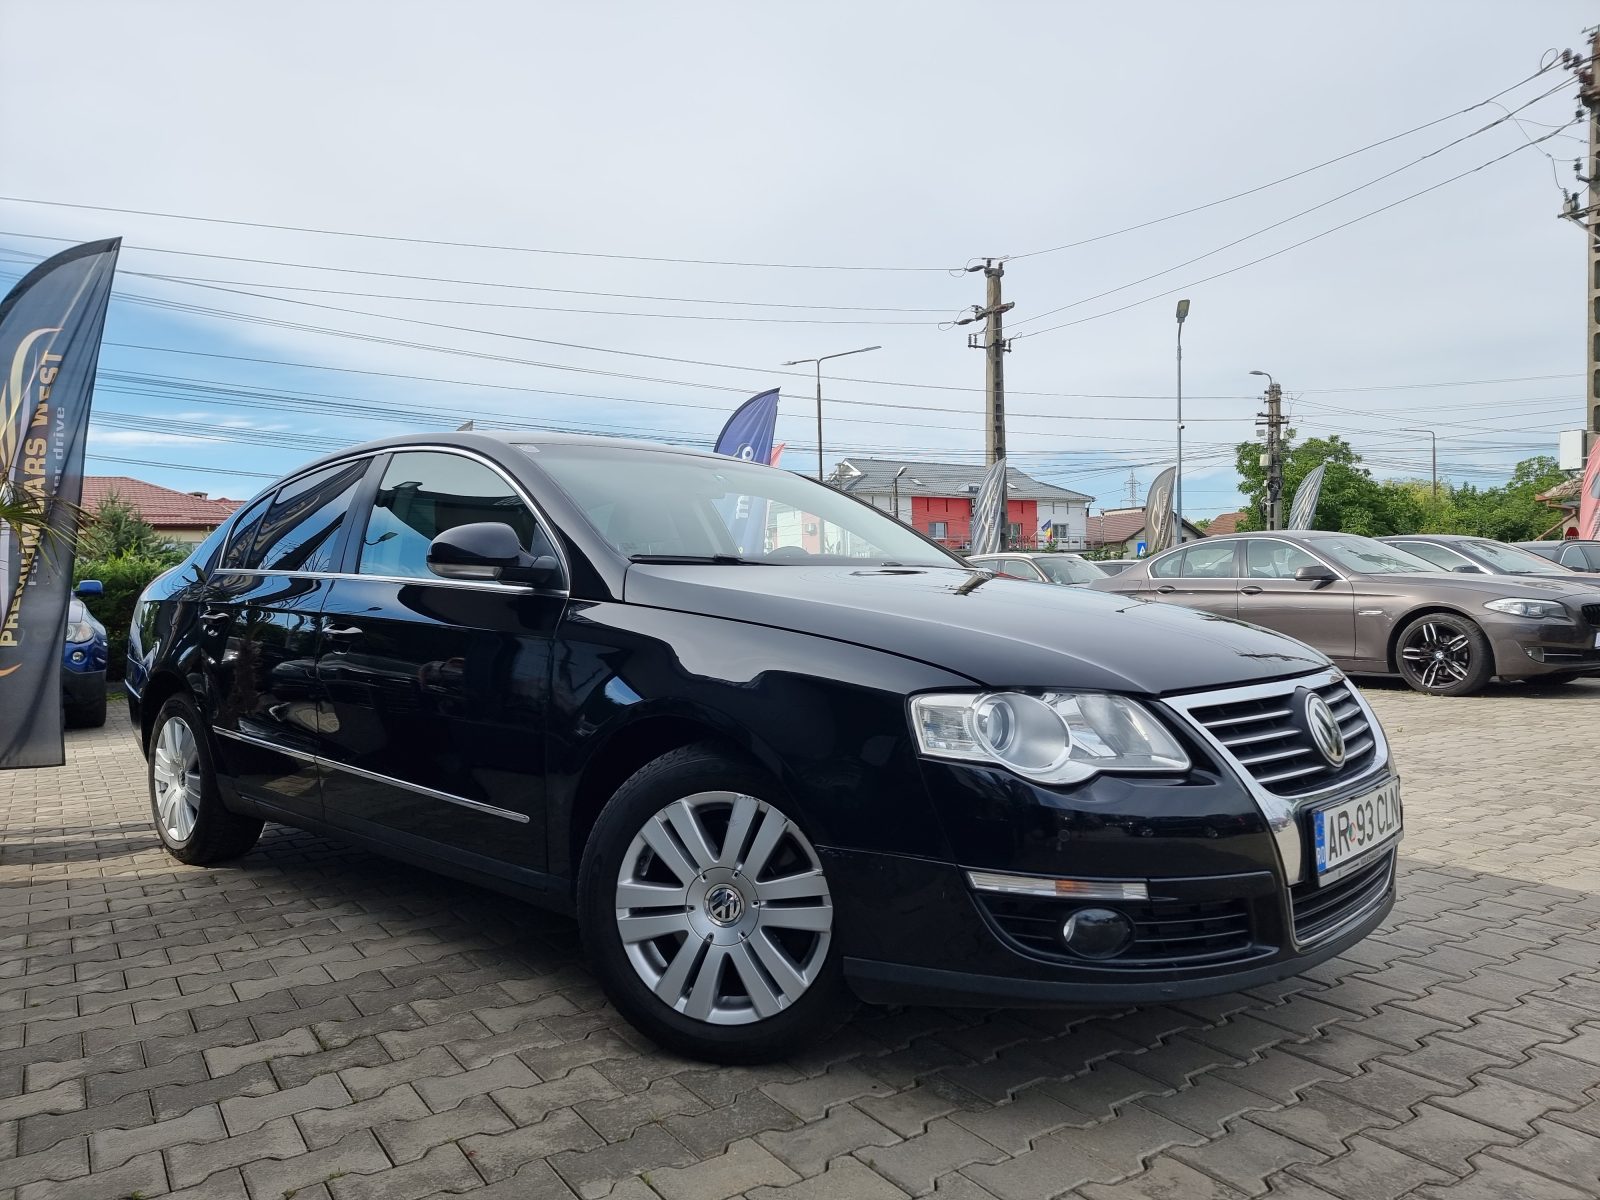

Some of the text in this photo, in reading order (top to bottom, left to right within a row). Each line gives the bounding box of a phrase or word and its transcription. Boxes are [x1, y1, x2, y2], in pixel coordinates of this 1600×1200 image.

[31, 351, 64, 427] WEST
[53, 406, 65, 460] drive
[1316, 846, 1326, 865] RO
[1329, 785, 1399, 861] AR 93 CLN
